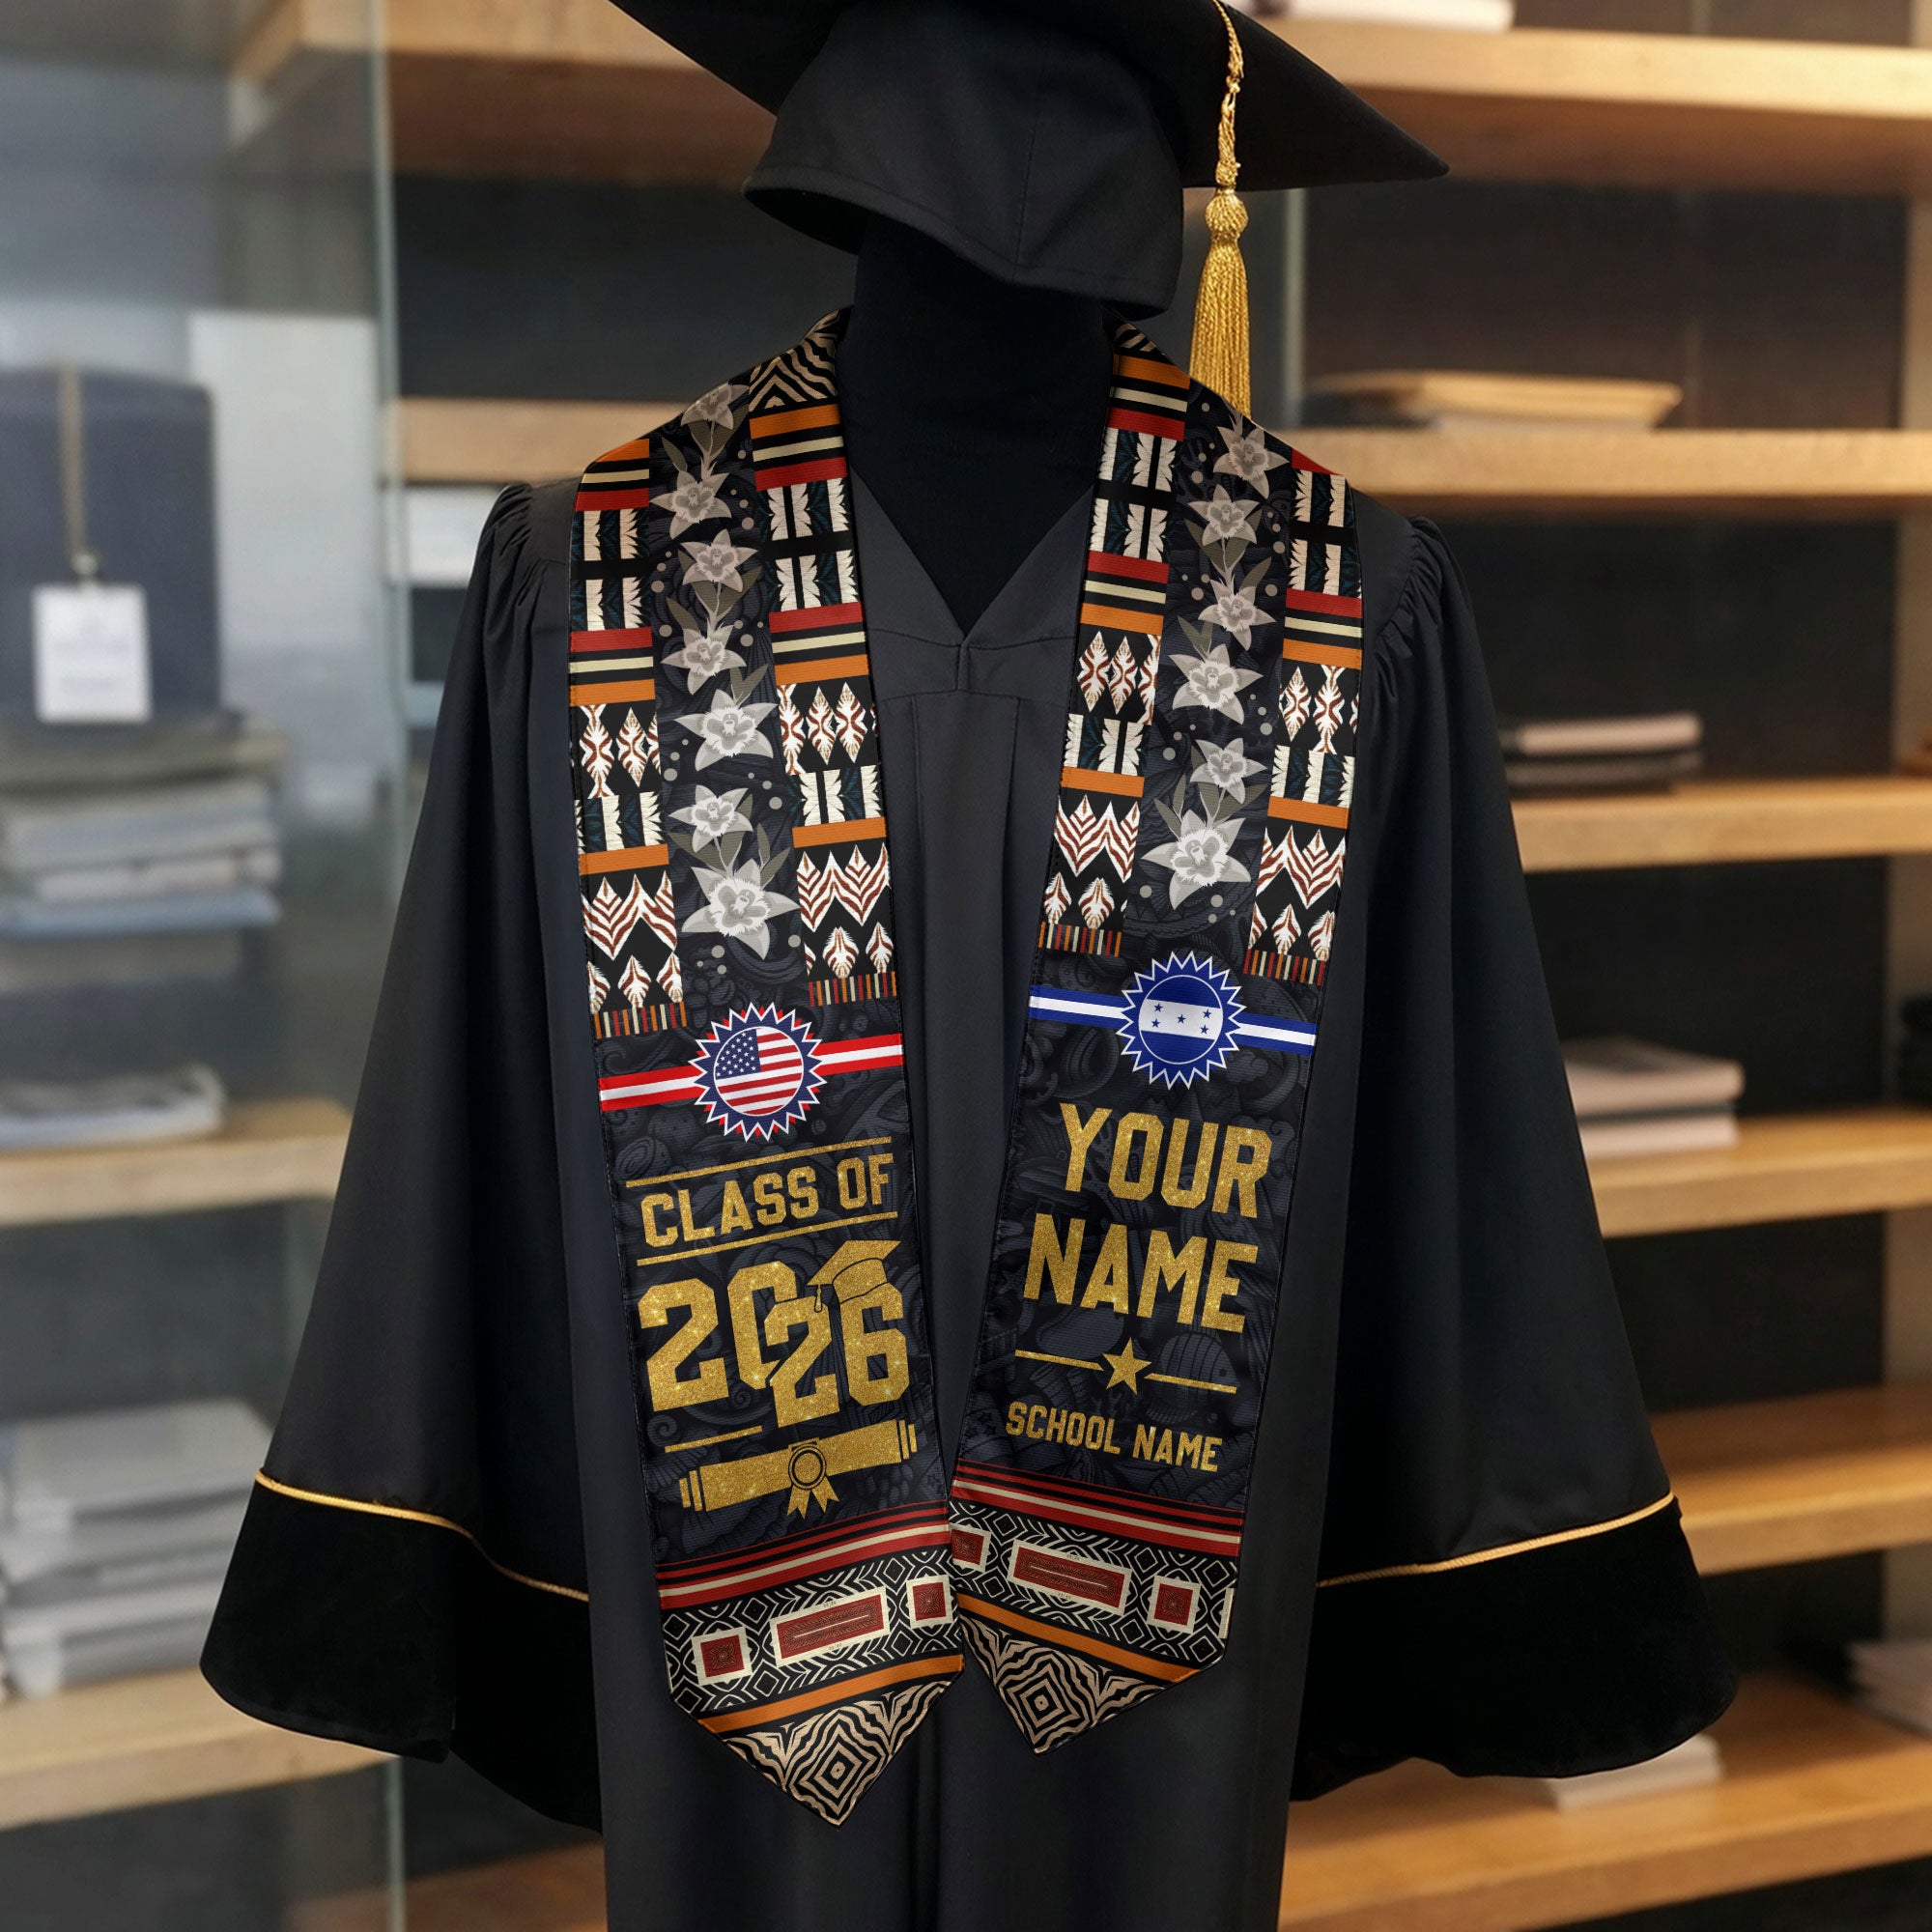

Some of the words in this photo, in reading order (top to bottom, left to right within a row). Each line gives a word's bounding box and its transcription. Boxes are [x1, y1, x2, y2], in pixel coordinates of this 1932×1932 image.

[640, 1166, 820, 1248] CLASS
[838, 1152, 895, 1209] OF
[1060, 1102, 1272, 1218] YOUR
[1023, 1212, 1259, 1333] NAME
[638, 1261, 910, 1428] 2026
[1006, 1401, 1121, 1454] SCHOOL
[1132, 1424, 1223, 1472] NAME
